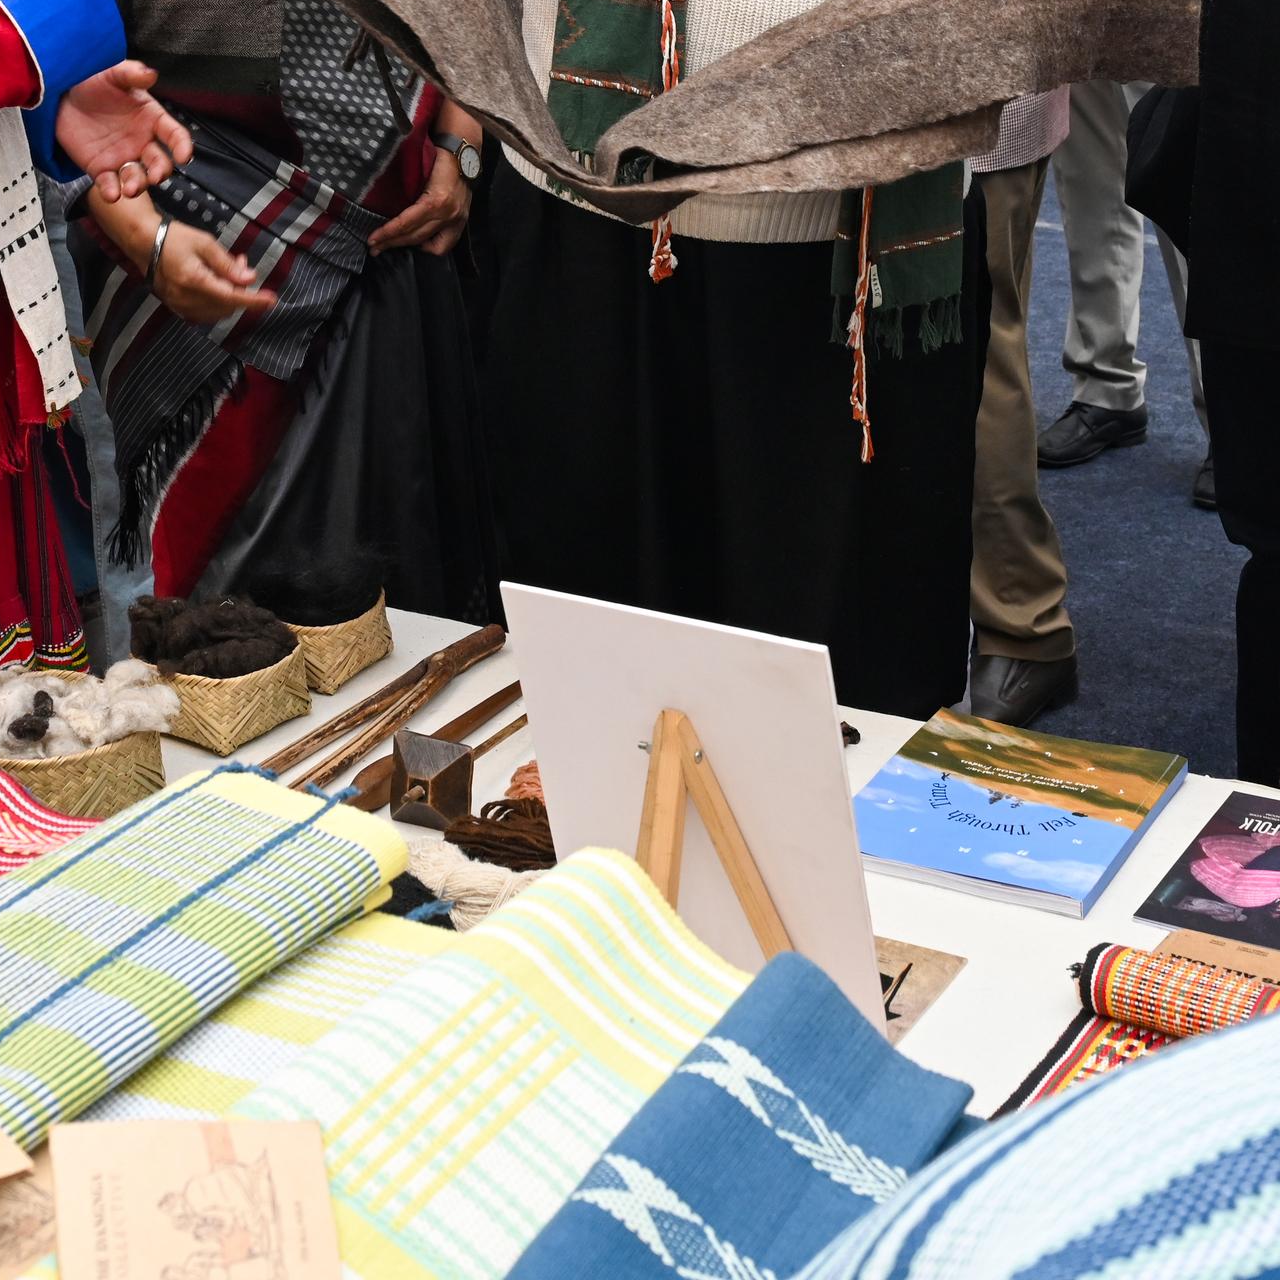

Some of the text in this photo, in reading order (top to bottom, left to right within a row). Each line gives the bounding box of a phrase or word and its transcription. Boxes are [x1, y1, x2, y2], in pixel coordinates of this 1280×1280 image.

[929, 782, 1077, 836] Felt Through Time
[1238, 817, 1280, 836] FOLK
